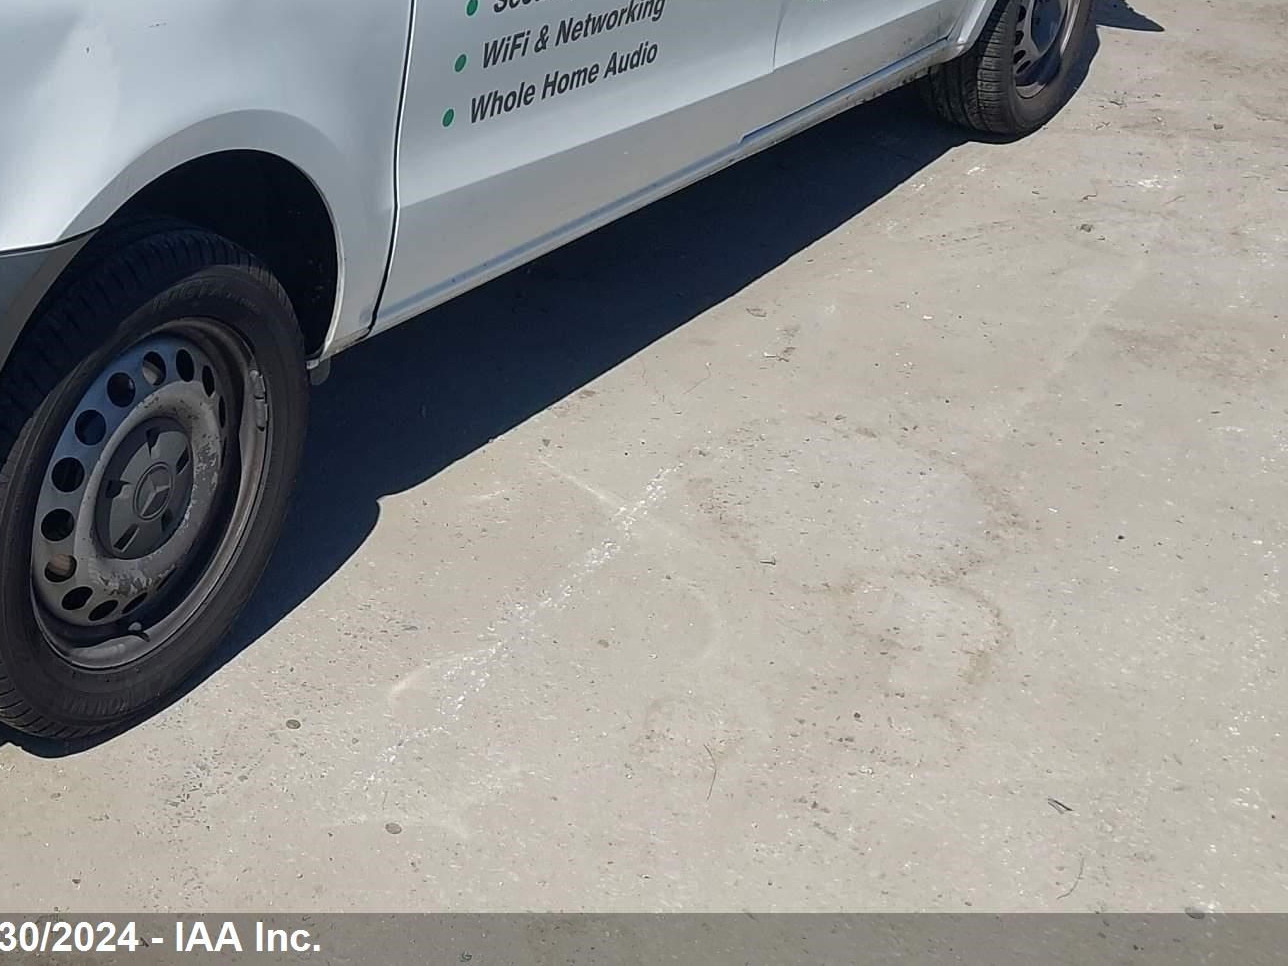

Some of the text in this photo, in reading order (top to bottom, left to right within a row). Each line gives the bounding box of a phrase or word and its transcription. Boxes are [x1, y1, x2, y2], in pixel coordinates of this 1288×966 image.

[481, 33, 530, 71] WiFi
[533, 24, 550, 52] &
[470, 38, 659, 125] Whole Home Audio
